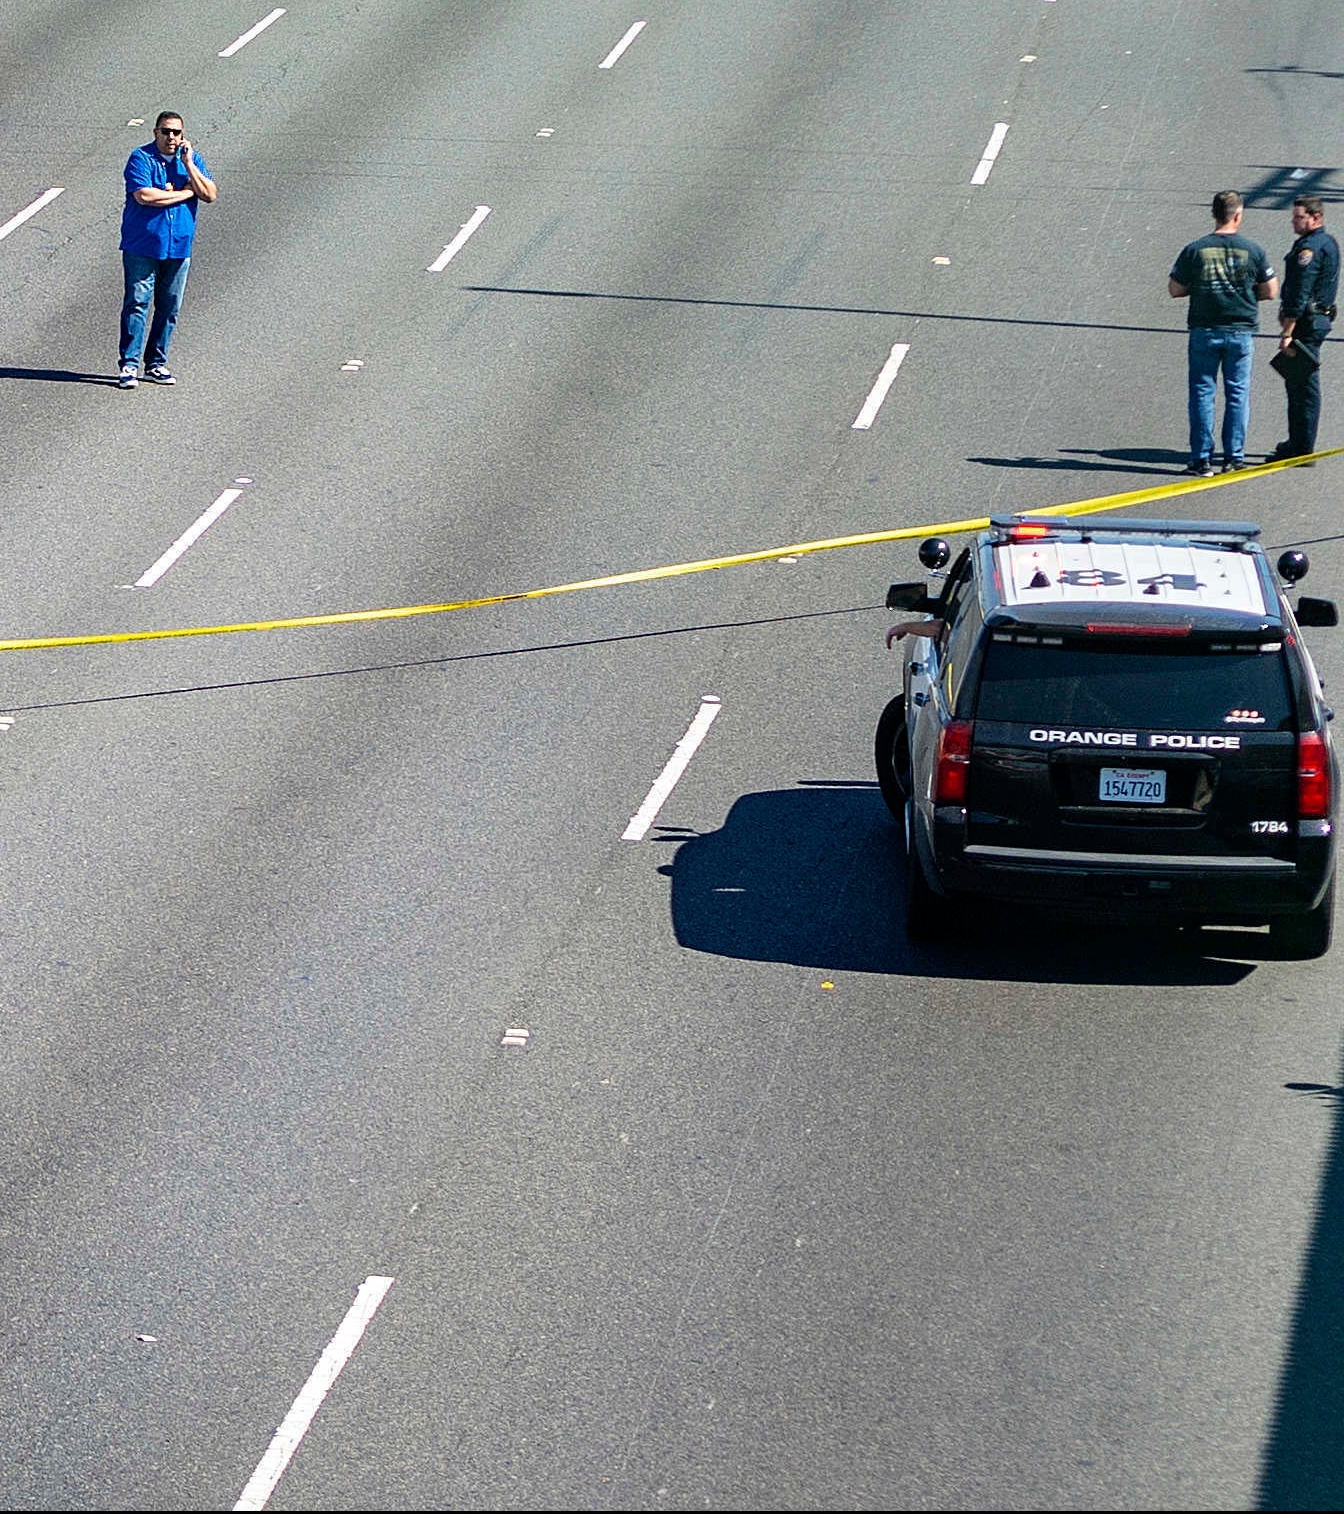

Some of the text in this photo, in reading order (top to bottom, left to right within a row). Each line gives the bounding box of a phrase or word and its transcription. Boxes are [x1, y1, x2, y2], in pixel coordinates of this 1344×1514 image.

[1029, 729, 1241, 749] ORANGE POLICE
[1103, 780, 1162, 798] 1547720
[1252, 821, 1289, 833] 1784
